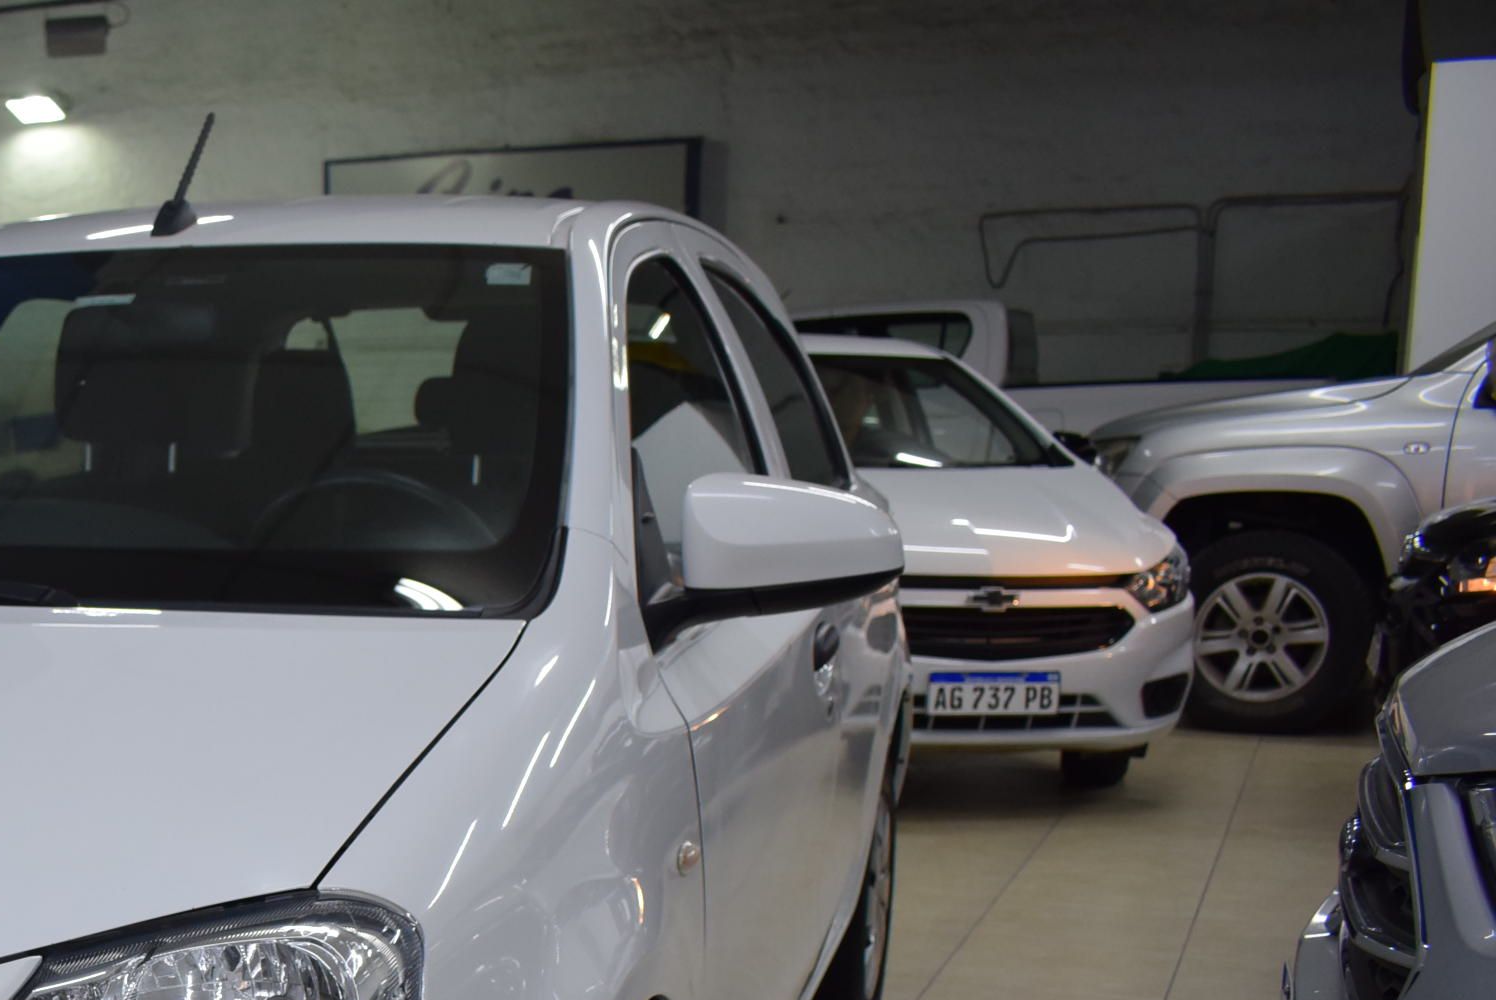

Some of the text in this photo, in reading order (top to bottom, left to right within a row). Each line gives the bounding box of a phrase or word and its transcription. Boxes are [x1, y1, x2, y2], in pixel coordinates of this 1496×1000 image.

[934, 686, 1053, 709] AG 737 PB
